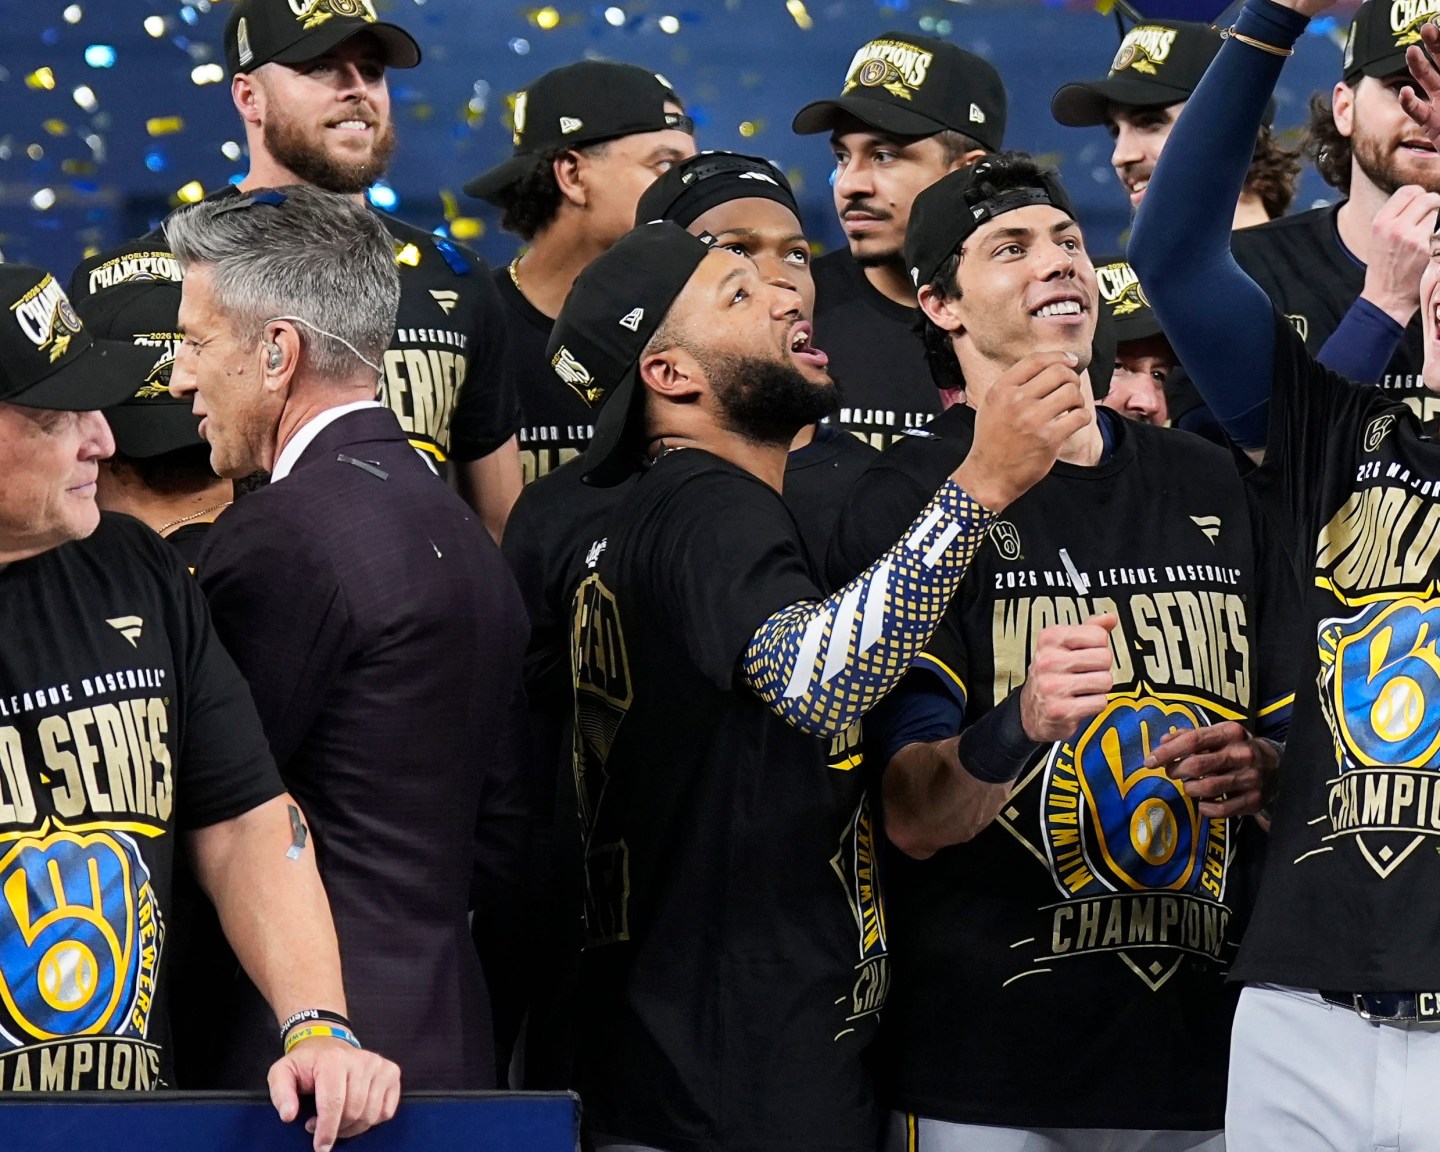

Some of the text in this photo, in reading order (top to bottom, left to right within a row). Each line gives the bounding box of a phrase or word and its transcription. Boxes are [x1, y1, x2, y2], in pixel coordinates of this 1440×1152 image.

[121, 251, 149, 261] WORLD
[89, 257, 186, 295] CHAMPION
[839, 408, 895, 426] MAJOR
[995, 565, 1237, 590] 2026 MAJR LEAGUE BASEBALL
[1130, 591, 1250, 709] SERIES
[82, 669, 162, 697] BASEBALL
[38, 698, 173, 822] SERIES
[1052, 898, 1230, 957] CHAMPIONS
